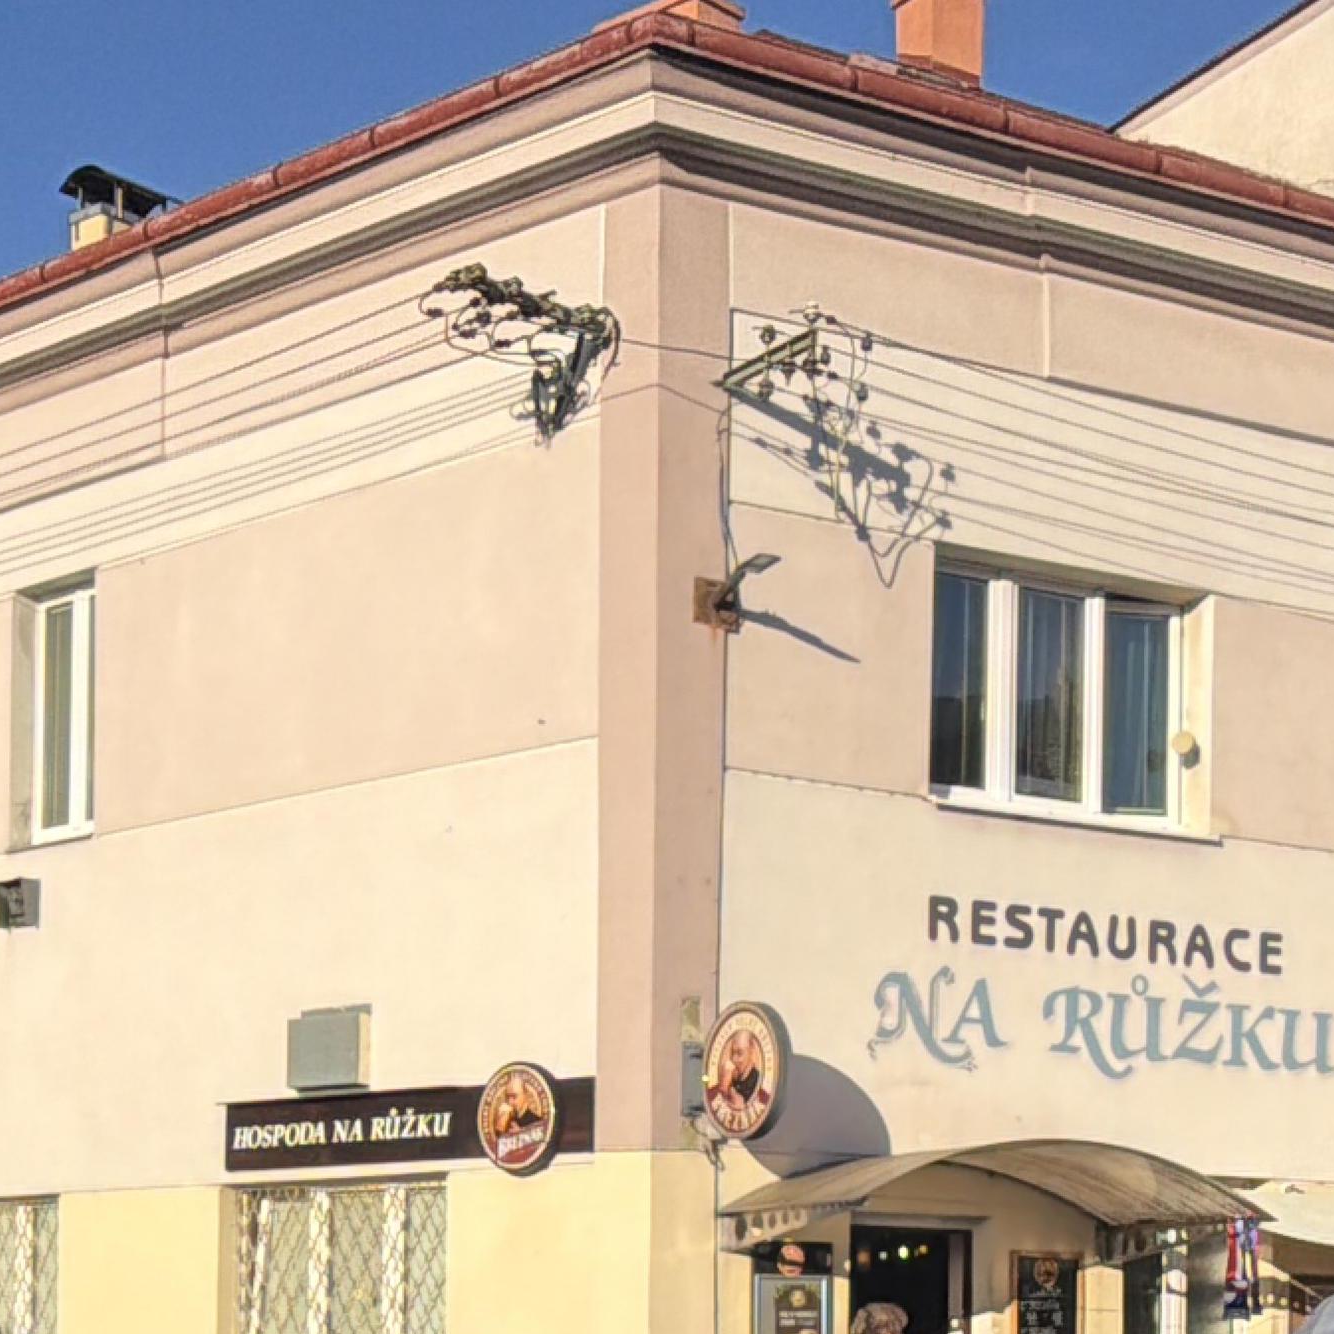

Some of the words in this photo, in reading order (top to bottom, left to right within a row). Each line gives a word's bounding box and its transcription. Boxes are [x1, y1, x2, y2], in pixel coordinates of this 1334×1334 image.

[928, 895, 1283, 975] RESTAURACE
[868, 965, 1008, 1073] NA
[232, 1120, 326, 1150] HOSPODA
[331, 1118, 364, 1144] NA
[370, 1106, 452, 1142] RŮŽKU
